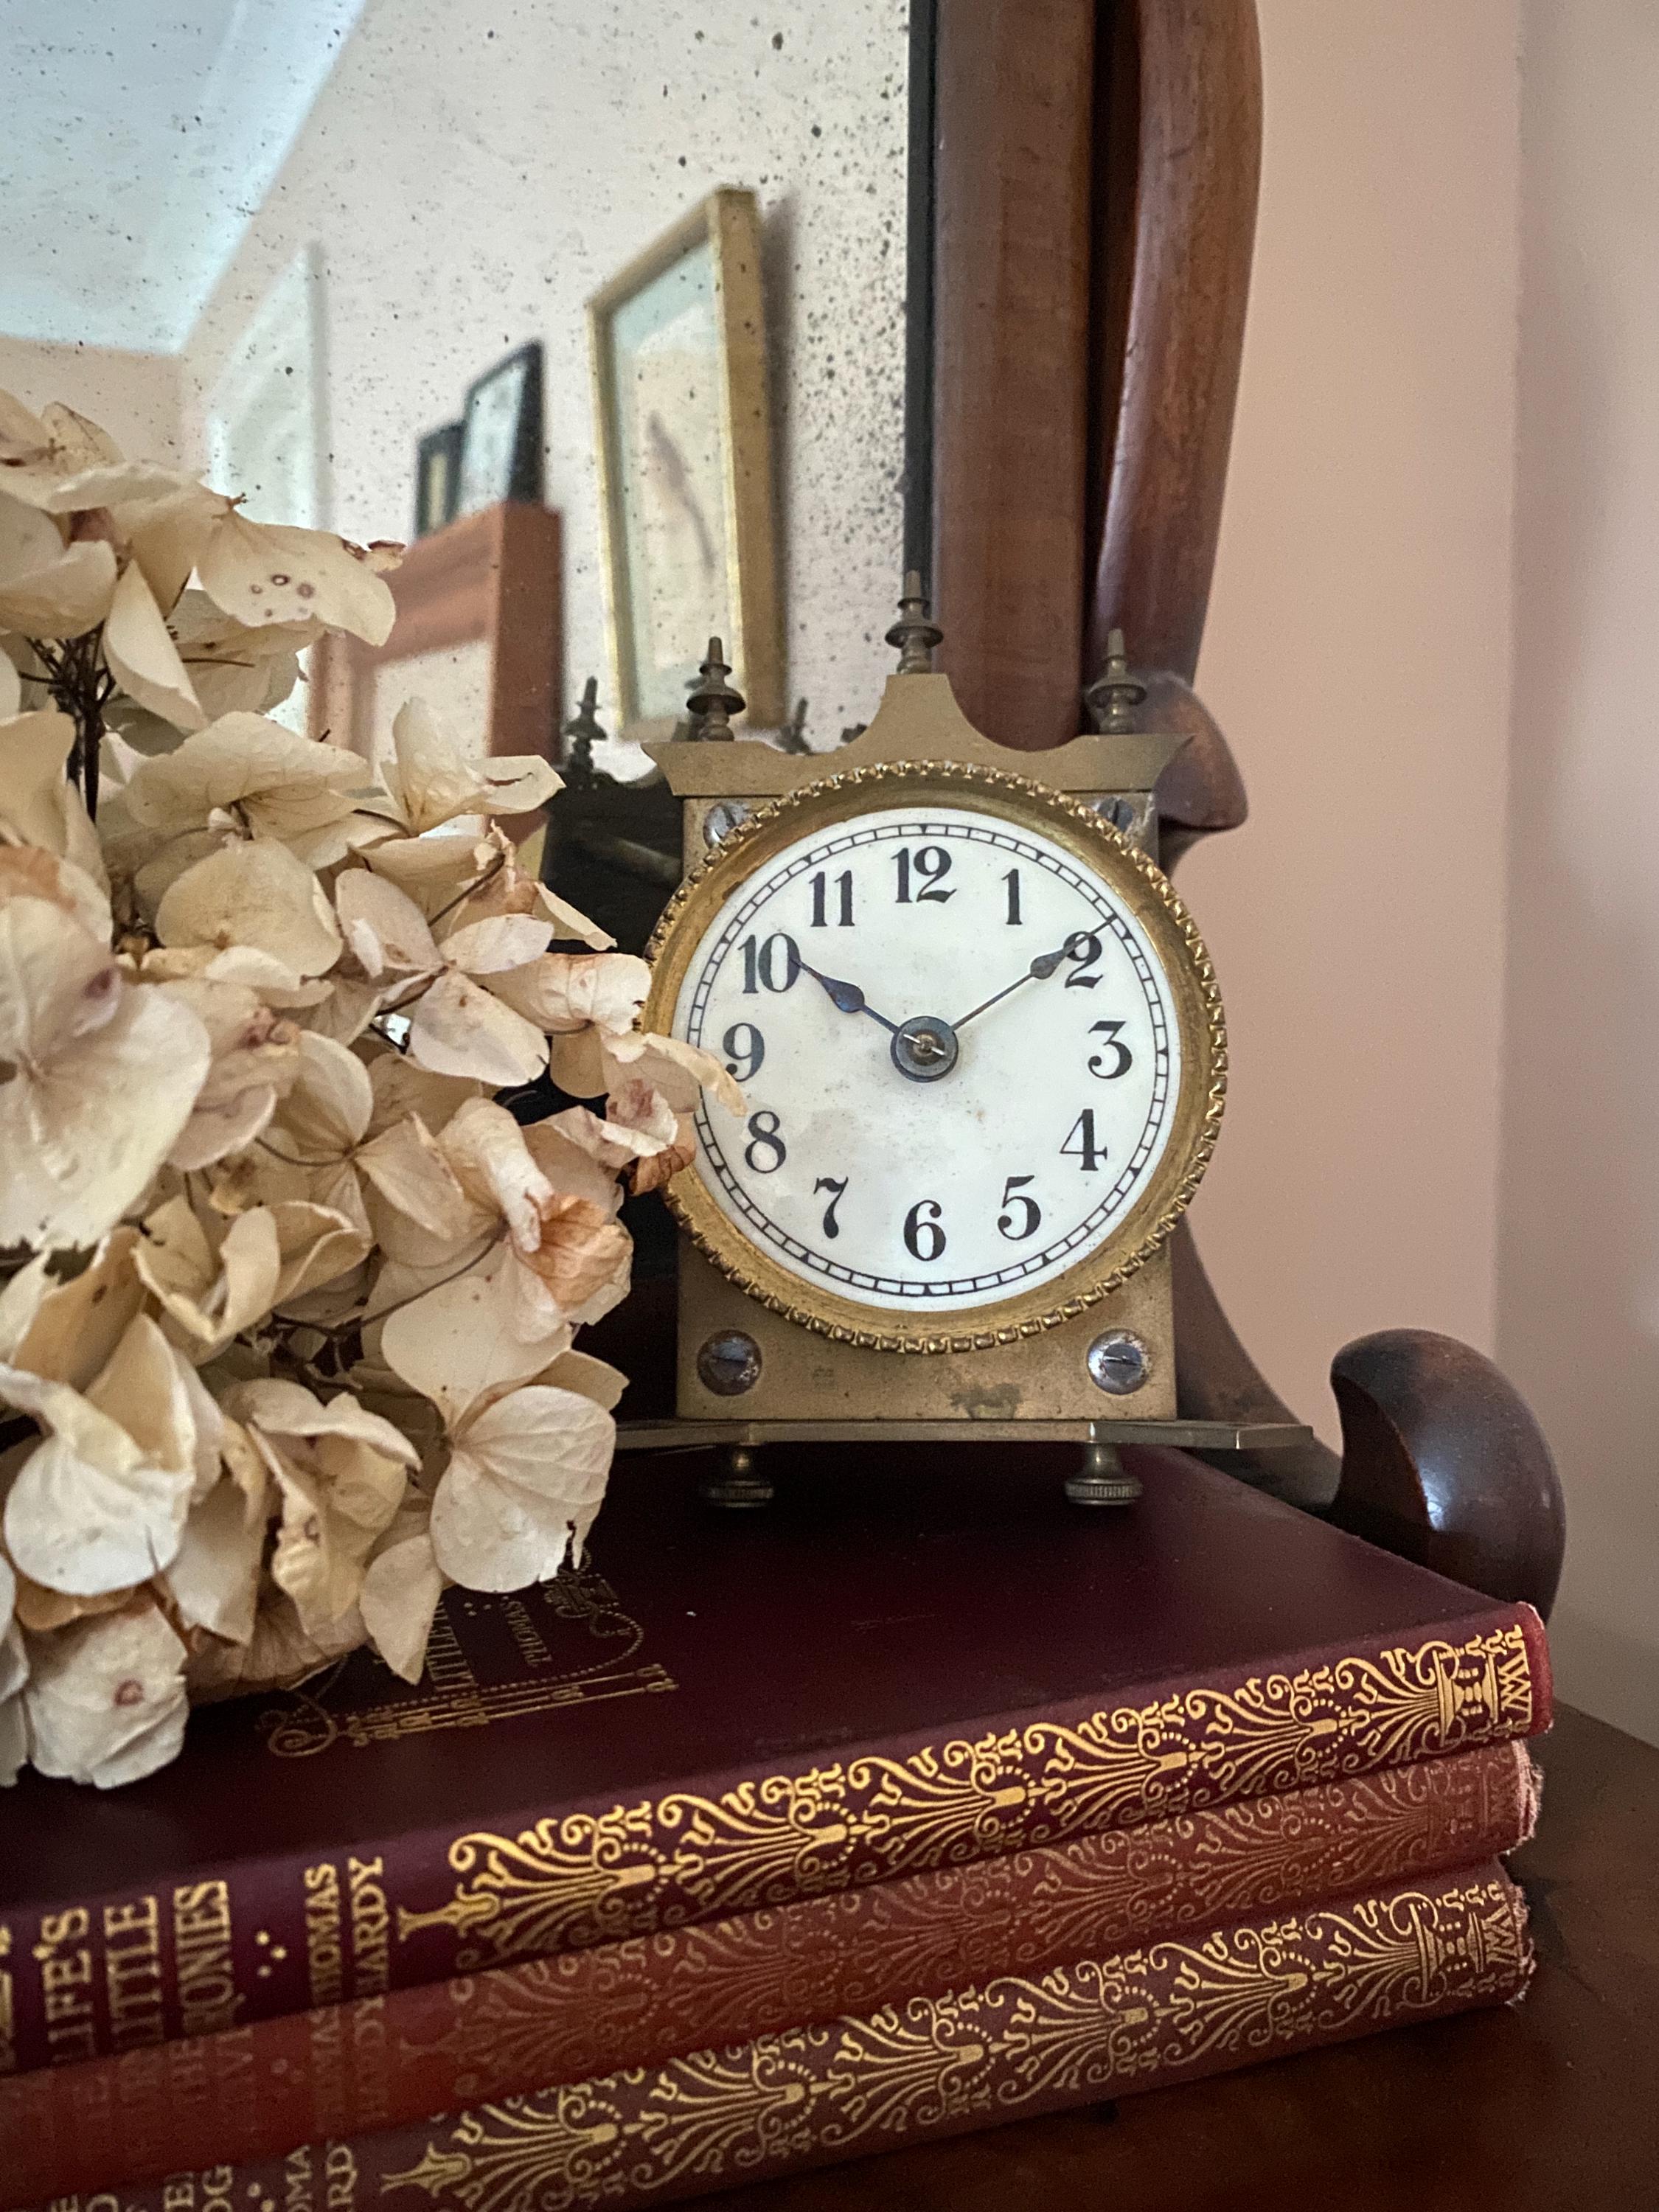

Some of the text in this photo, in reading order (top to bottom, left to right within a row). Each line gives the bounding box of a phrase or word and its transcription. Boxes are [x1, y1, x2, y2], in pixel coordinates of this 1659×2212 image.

[809, 870, 855, 928] 11
[891, 846, 957, 903] 12
[1001, 869, 1023, 925] 1
[737, 933, 801, 995] 10
[1064, 931, 1103, 990] 2
[723, 1023, 765, 1082] 9
[1088, 1020, 1133, 1079] 3
[744, 1111, 786, 1173] 8
[1060, 1109, 1107, 1171] 4
[813, 1176, 849, 1239] 7
[903, 1200, 946, 1261] 6
[998, 1175, 1041, 1240] 5
[504, 1600, 552, 1667] THOMAS
[103, 1896, 164, 2048] LITTLE
[174, 1880, 246, 2038] RONIES
